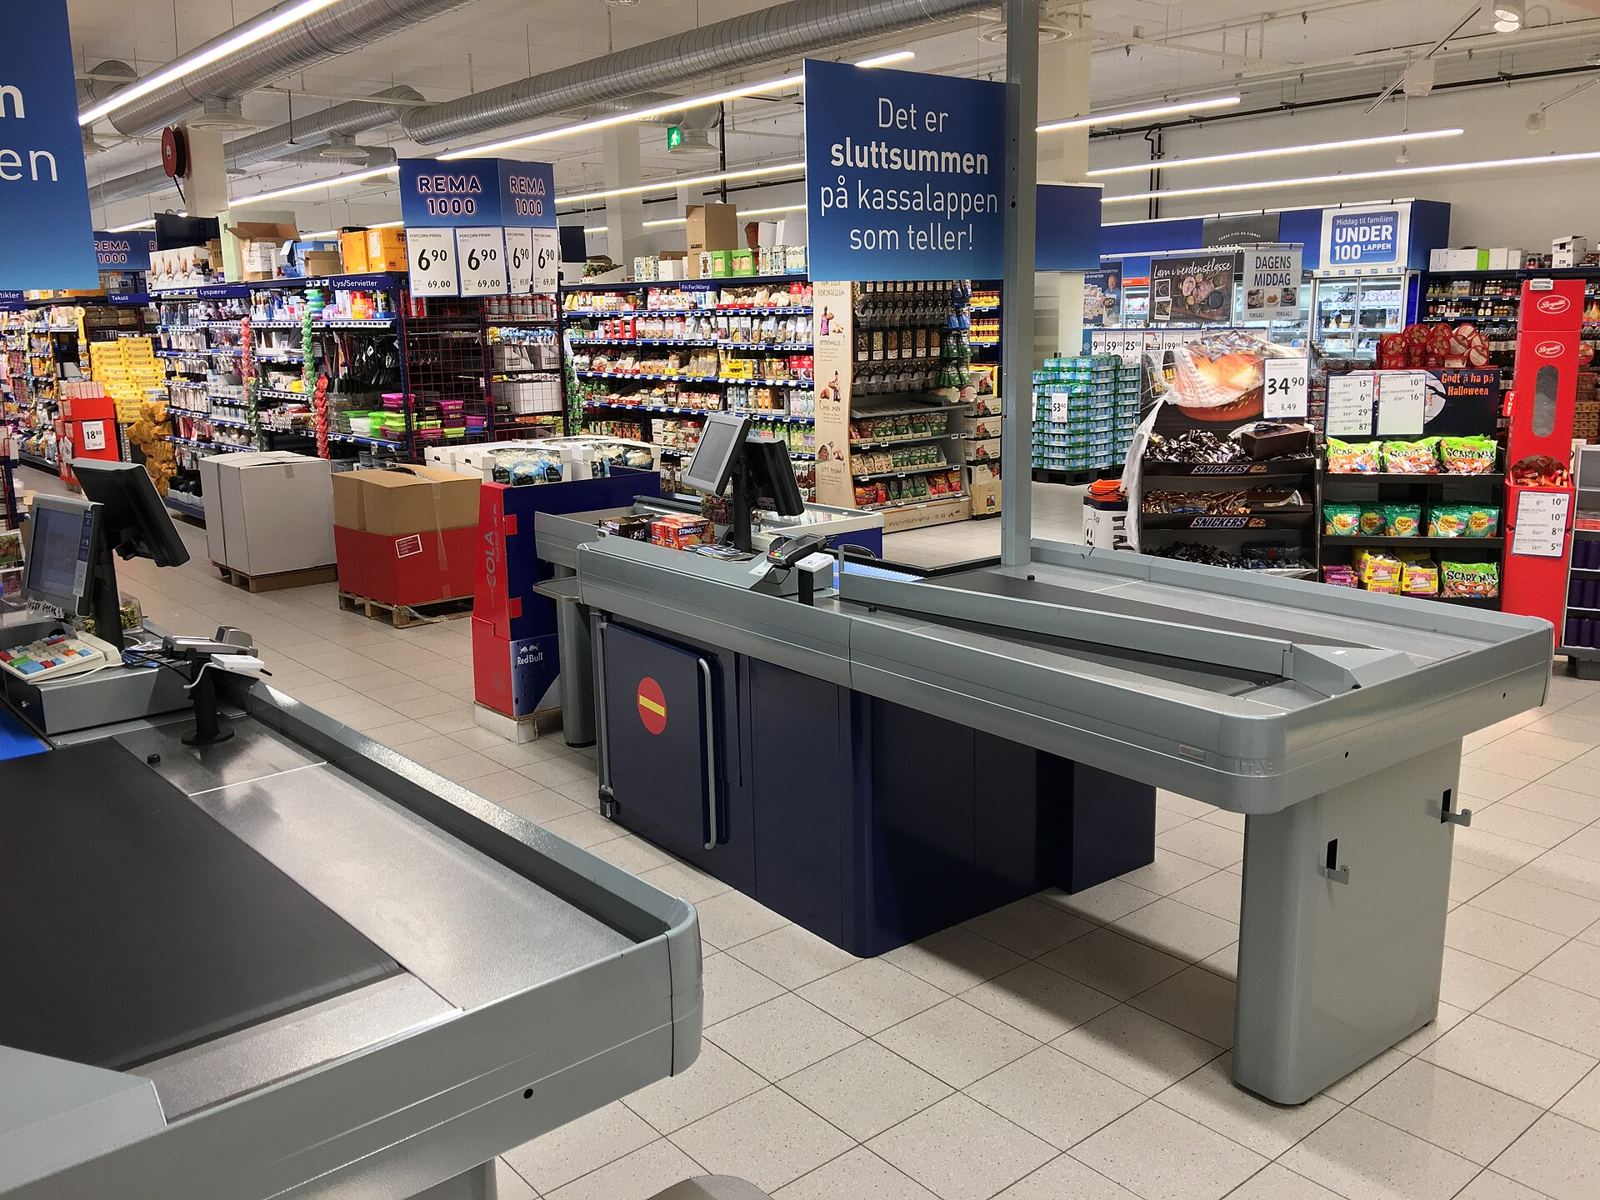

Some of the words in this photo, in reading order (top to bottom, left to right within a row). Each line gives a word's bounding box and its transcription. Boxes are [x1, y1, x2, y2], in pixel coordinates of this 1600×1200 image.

[878, 97, 917, 131] Det
[925, 108, 949, 133] er
[830, 136, 989, 175] sluttsummen
[418, 176, 482, 194] REMA
[510, 176, 545, 196] REMA
[820, 175, 848, 216] på
[858, 180, 998, 220] kassalappen
[428, 198, 476, 215] 1000
[516, 200, 543, 216] 1000
[1367, 216, 1394, 224] familien
[850, 226, 899, 250] som
[907, 223, 973, 251] teller!
[1336, 224, 1392, 243] UNDER
[94, 240, 130, 251] REMA
[1334, 244, 1361, 260] 100
[1362, 243, 1392, 251] LAPPEN
[98, 253, 128, 263] 1000
[1256, 256, 1292, 270] DAGENS
[1254, 273, 1291, 286] MIDDAG
[1442, 373, 1460, 384] Godt
[1471, 373, 1482, 382] ha
[1484, 373, 1494, 384] på
[1448, 386, 1489, 396] Halloween
[1446, 447, 1475, 459] SCARY
[1477, 450, 1495, 459] MIX
[1192, 465, 1248, 474] SNICKERS
[1190, 517, 1247, 527] SNICKERS
[1446, 571, 1477, 581] SCARY
[1479, 571, 1497, 584] MIX
